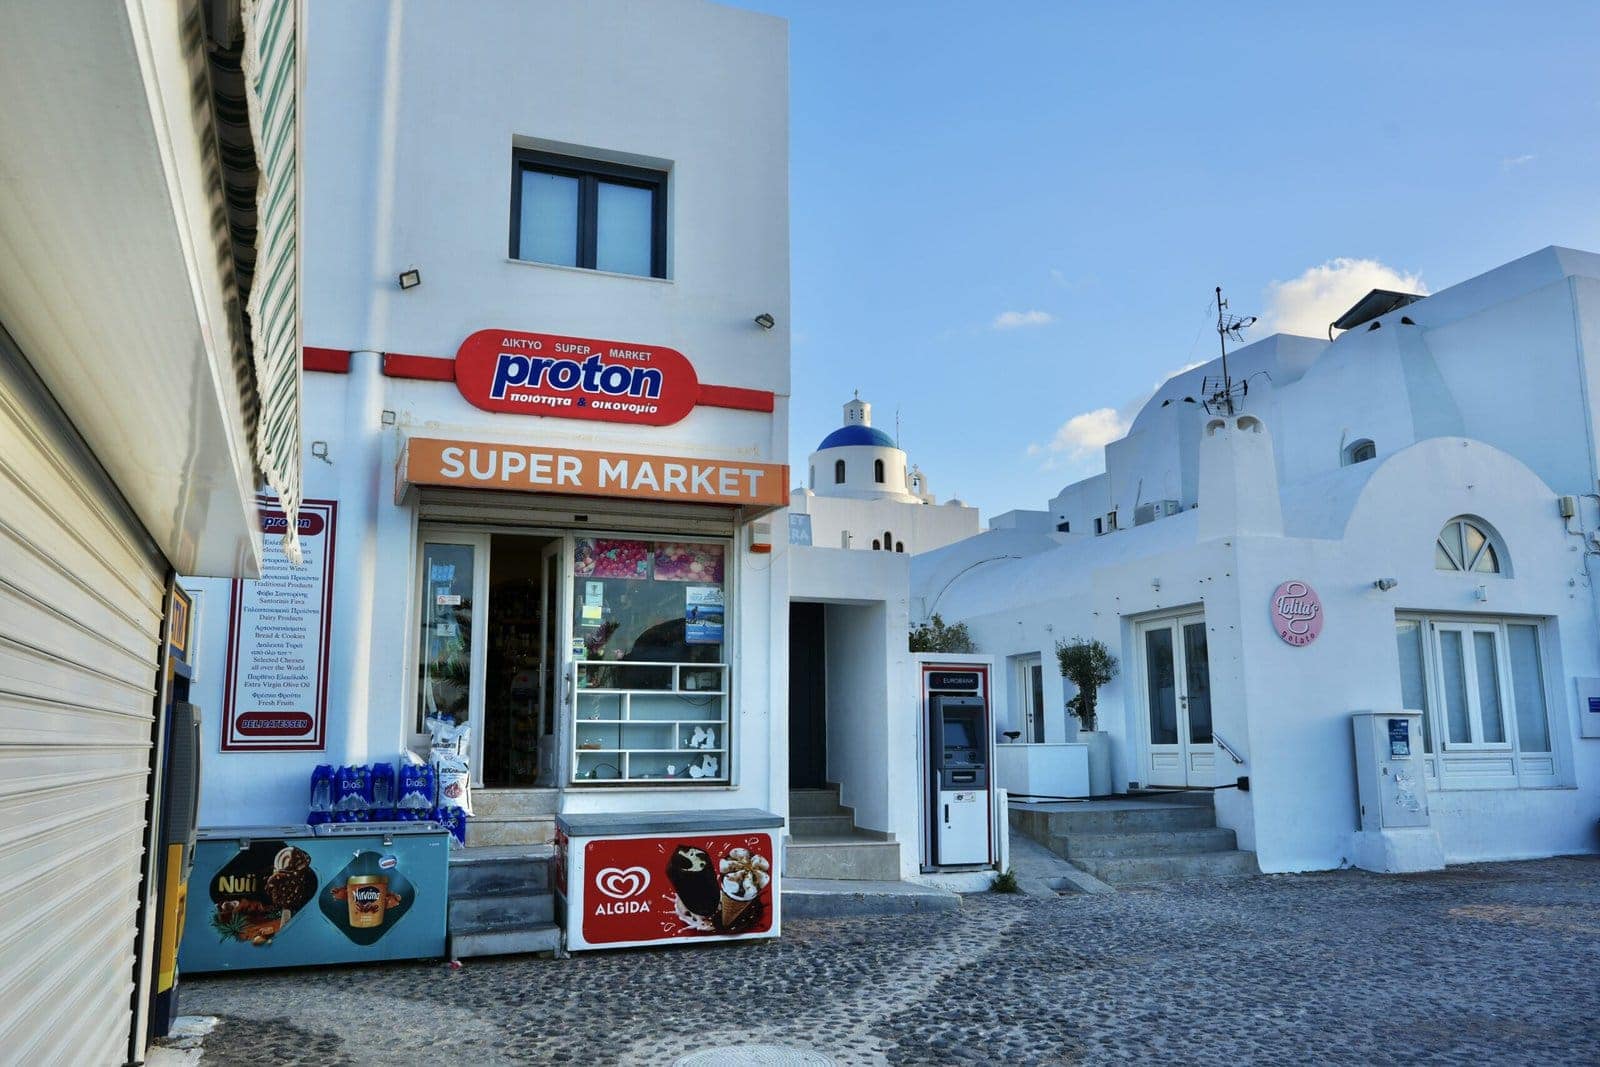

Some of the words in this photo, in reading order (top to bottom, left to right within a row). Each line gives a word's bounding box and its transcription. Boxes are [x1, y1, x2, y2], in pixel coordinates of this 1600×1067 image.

[502, 337, 542, 350] ΔΙΚΤΥΟ
[555, 342, 591, 355] SUPER
[609, 348, 652, 361] MARKET
[490, 353, 663, 400] proton
[577, 397, 586, 407] &
[591, 400, 657, 414] οικονομία
[440, 447, 583, 486] SUPER
[598, 458, 765, 497] MARKET
[242, 720, 308, 729] DELICATESSEN
[595, 901, 650, 915] ALGIDA
